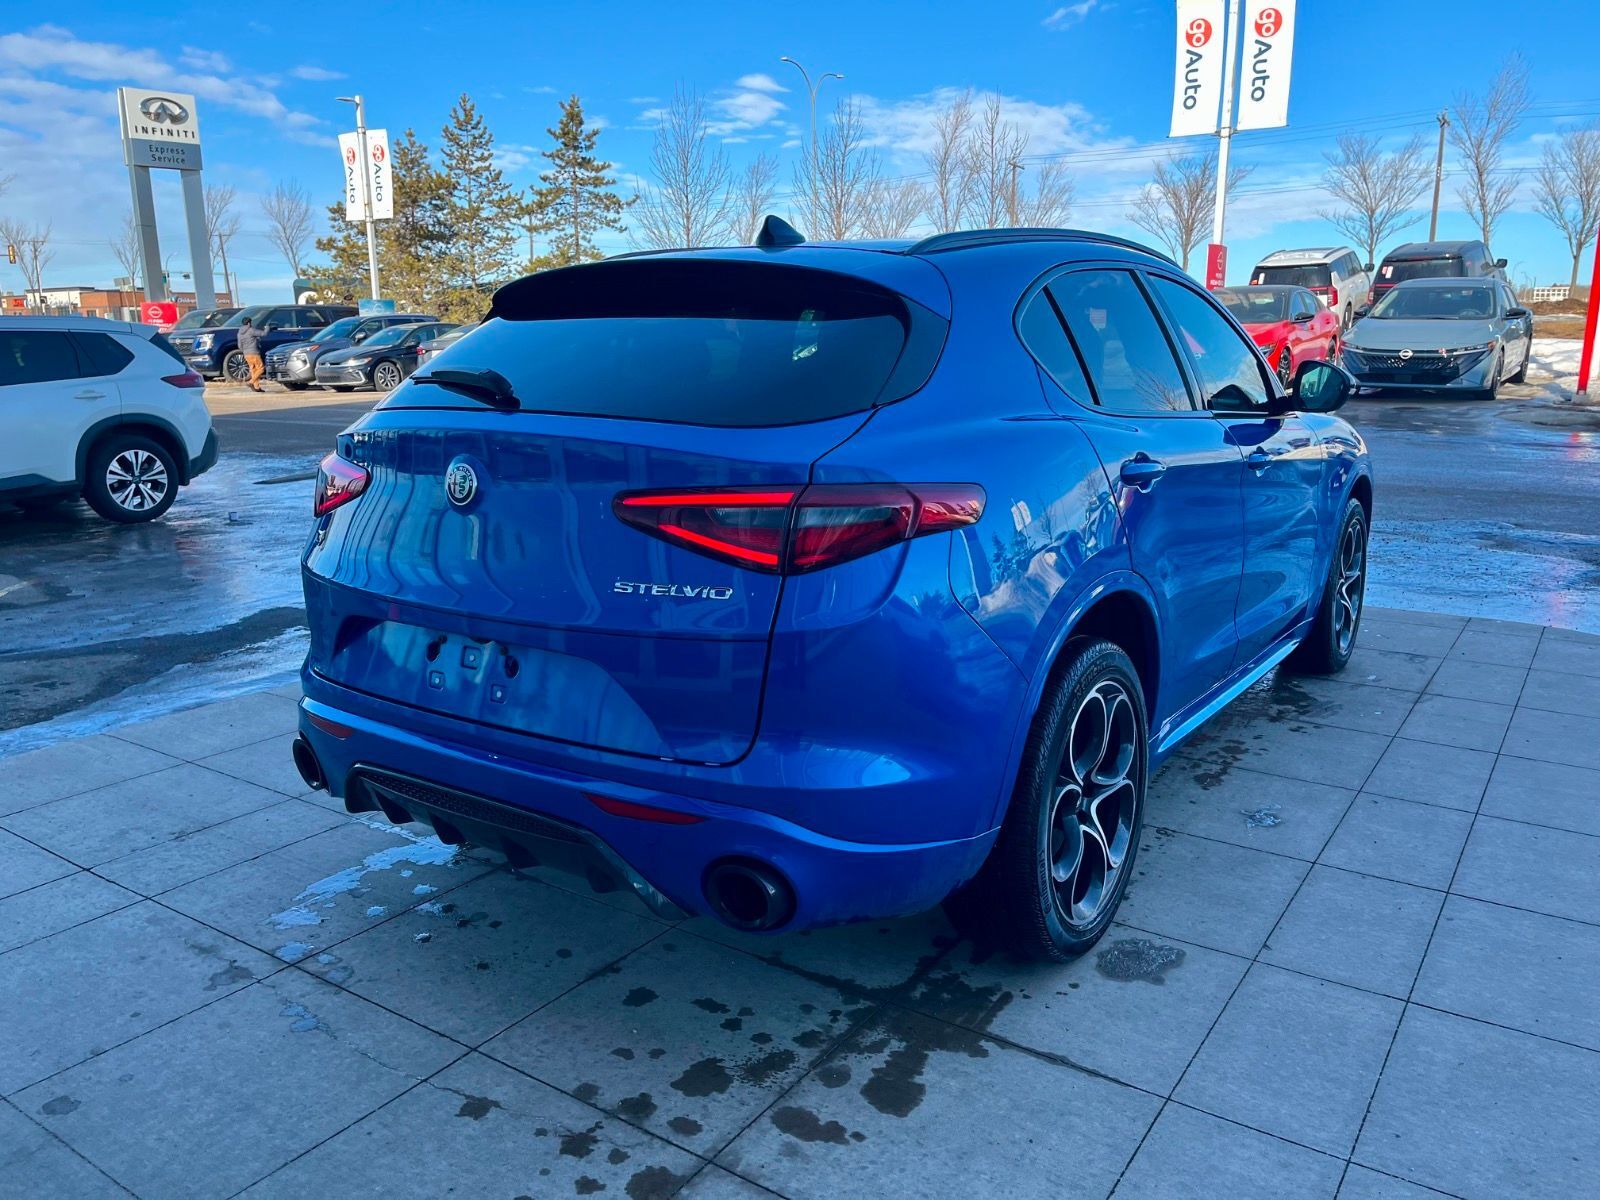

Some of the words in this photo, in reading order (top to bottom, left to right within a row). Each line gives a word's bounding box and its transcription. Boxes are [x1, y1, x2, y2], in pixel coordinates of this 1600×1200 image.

[1187, 19, 1206, 47] go
[1256, 8, 1276, 37] go
[1183, 49, 1203, 110] Auto
[1250, 39, 1273, 102] Auto
[134, 125, 196, 139] INFINITI
[149, 144, 186, 155] Express
[151, 154, 186, 164] Service
[348, 166, 356, 204] Auto
[373, 163, 384, 202] Auto
[613, 581, 733, 600] STELVIO
